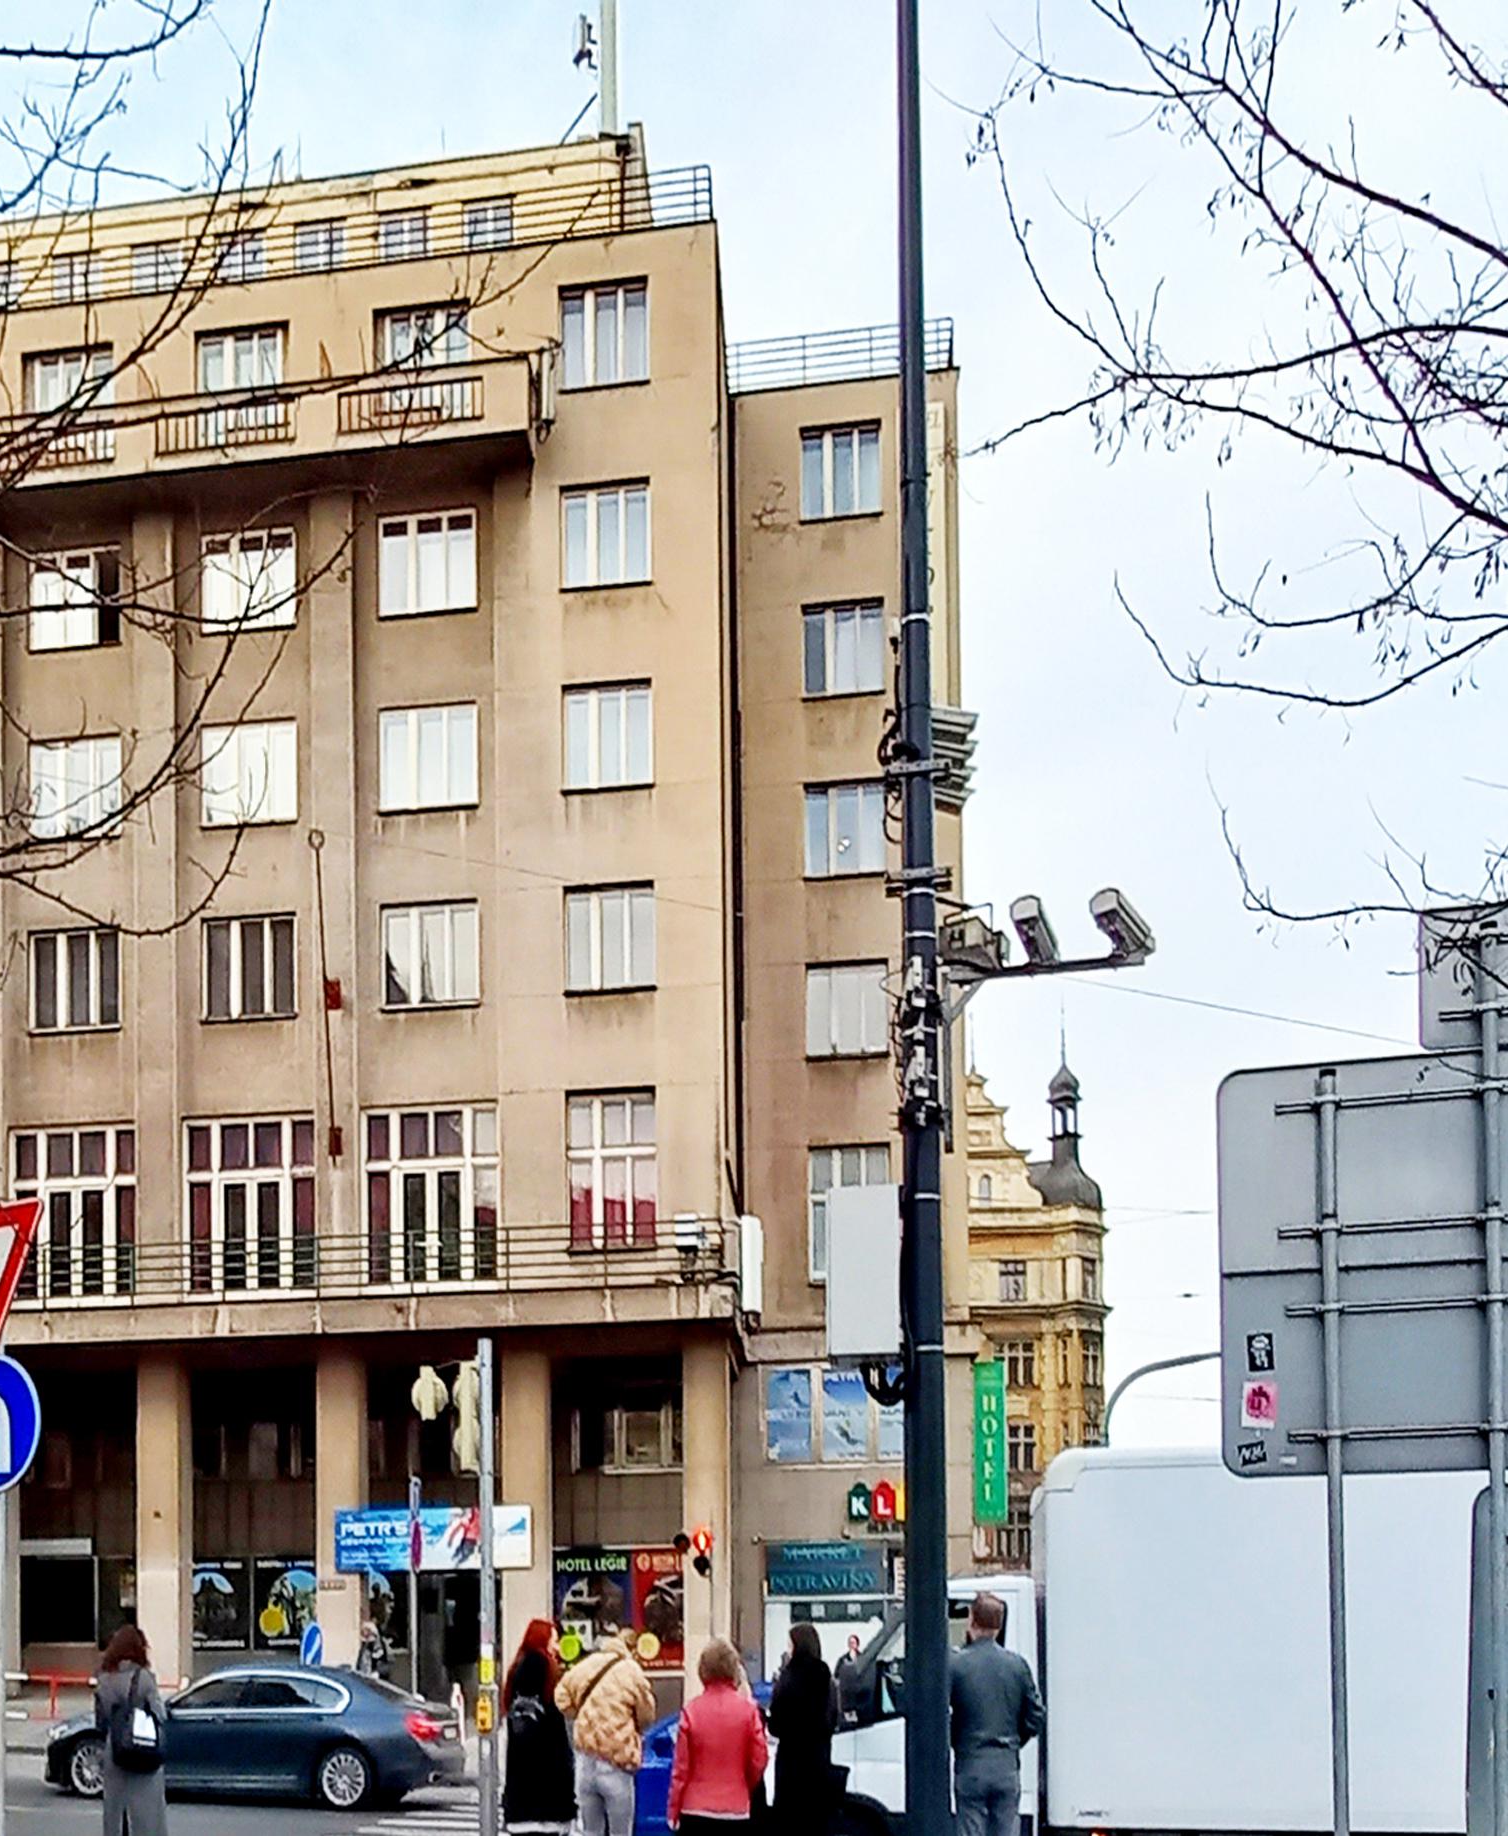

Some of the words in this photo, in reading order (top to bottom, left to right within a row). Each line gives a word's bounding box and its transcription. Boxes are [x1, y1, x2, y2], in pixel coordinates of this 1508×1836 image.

[981, 1393, 999, 1501] HOTEL
[556, 1557, 592, 1572] HOTEL
[770, 1568, 878, 1590] POTRAVINY
